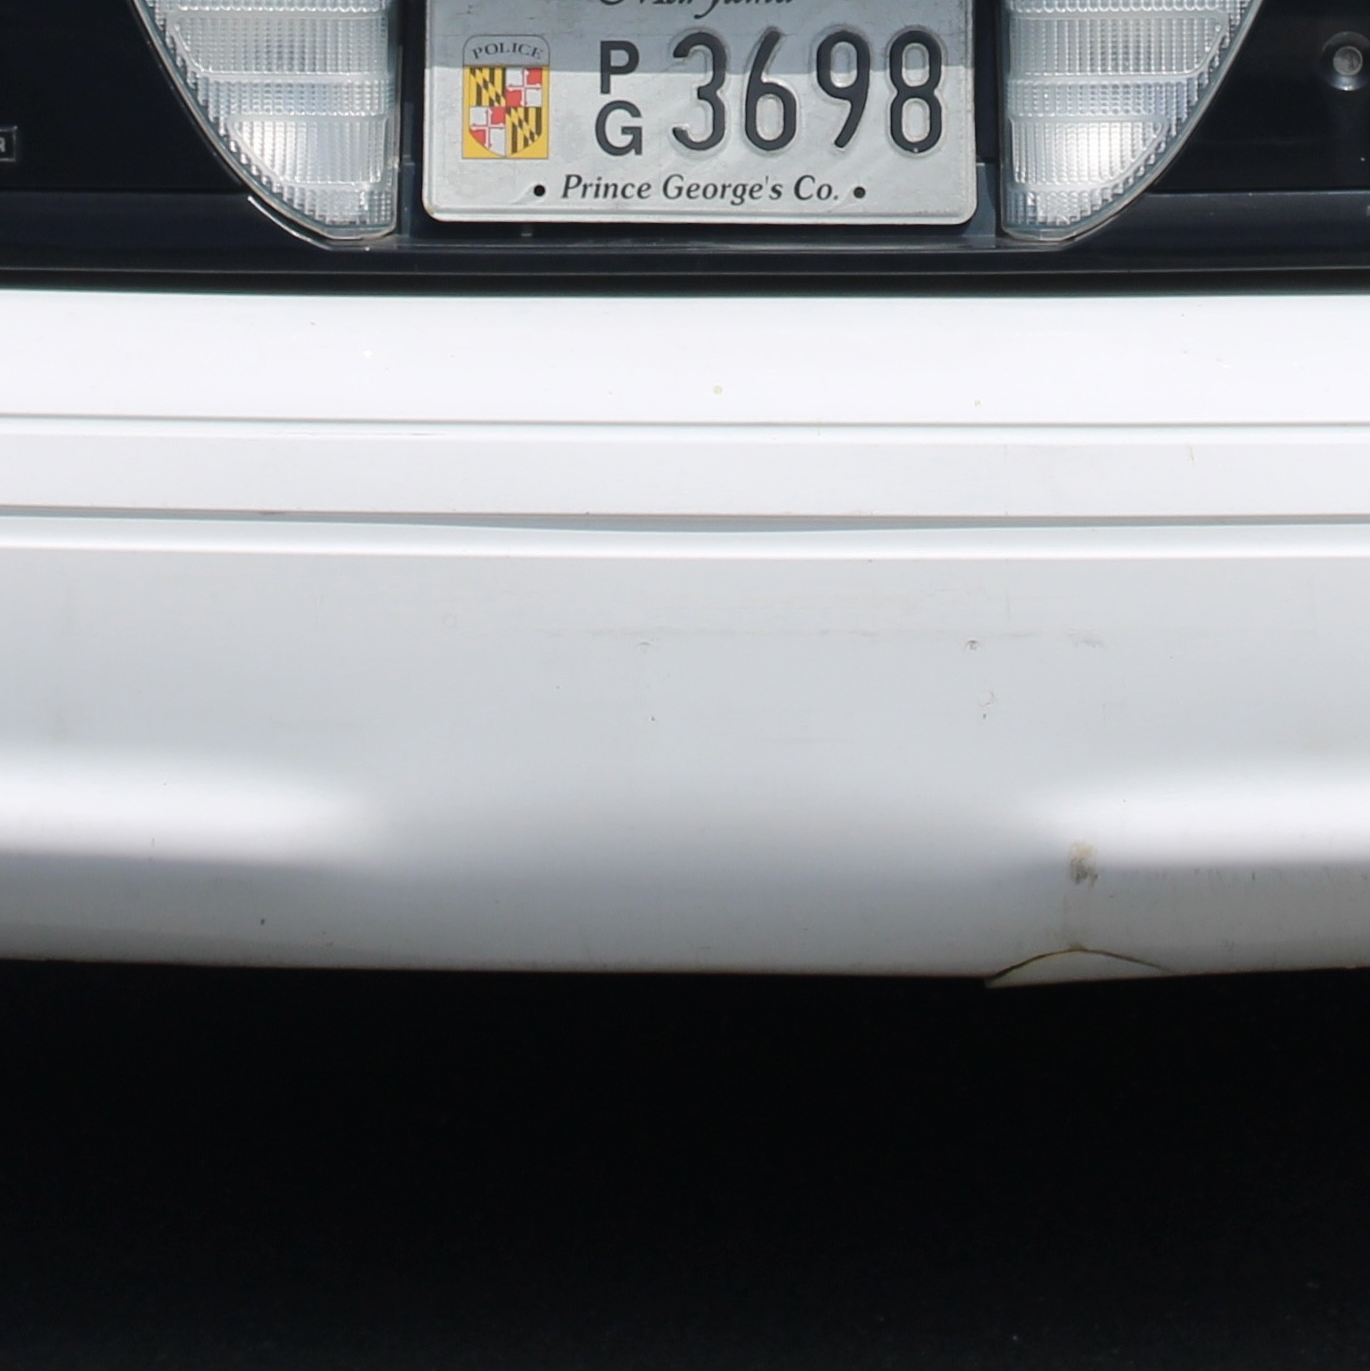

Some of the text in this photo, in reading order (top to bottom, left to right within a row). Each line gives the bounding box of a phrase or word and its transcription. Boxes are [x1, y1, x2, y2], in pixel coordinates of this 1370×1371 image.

[472, 42, 544, 60] POLICE
[672, 30, 943, 152] 3698
[561, 174, 840, 205] Prince George's Co.
